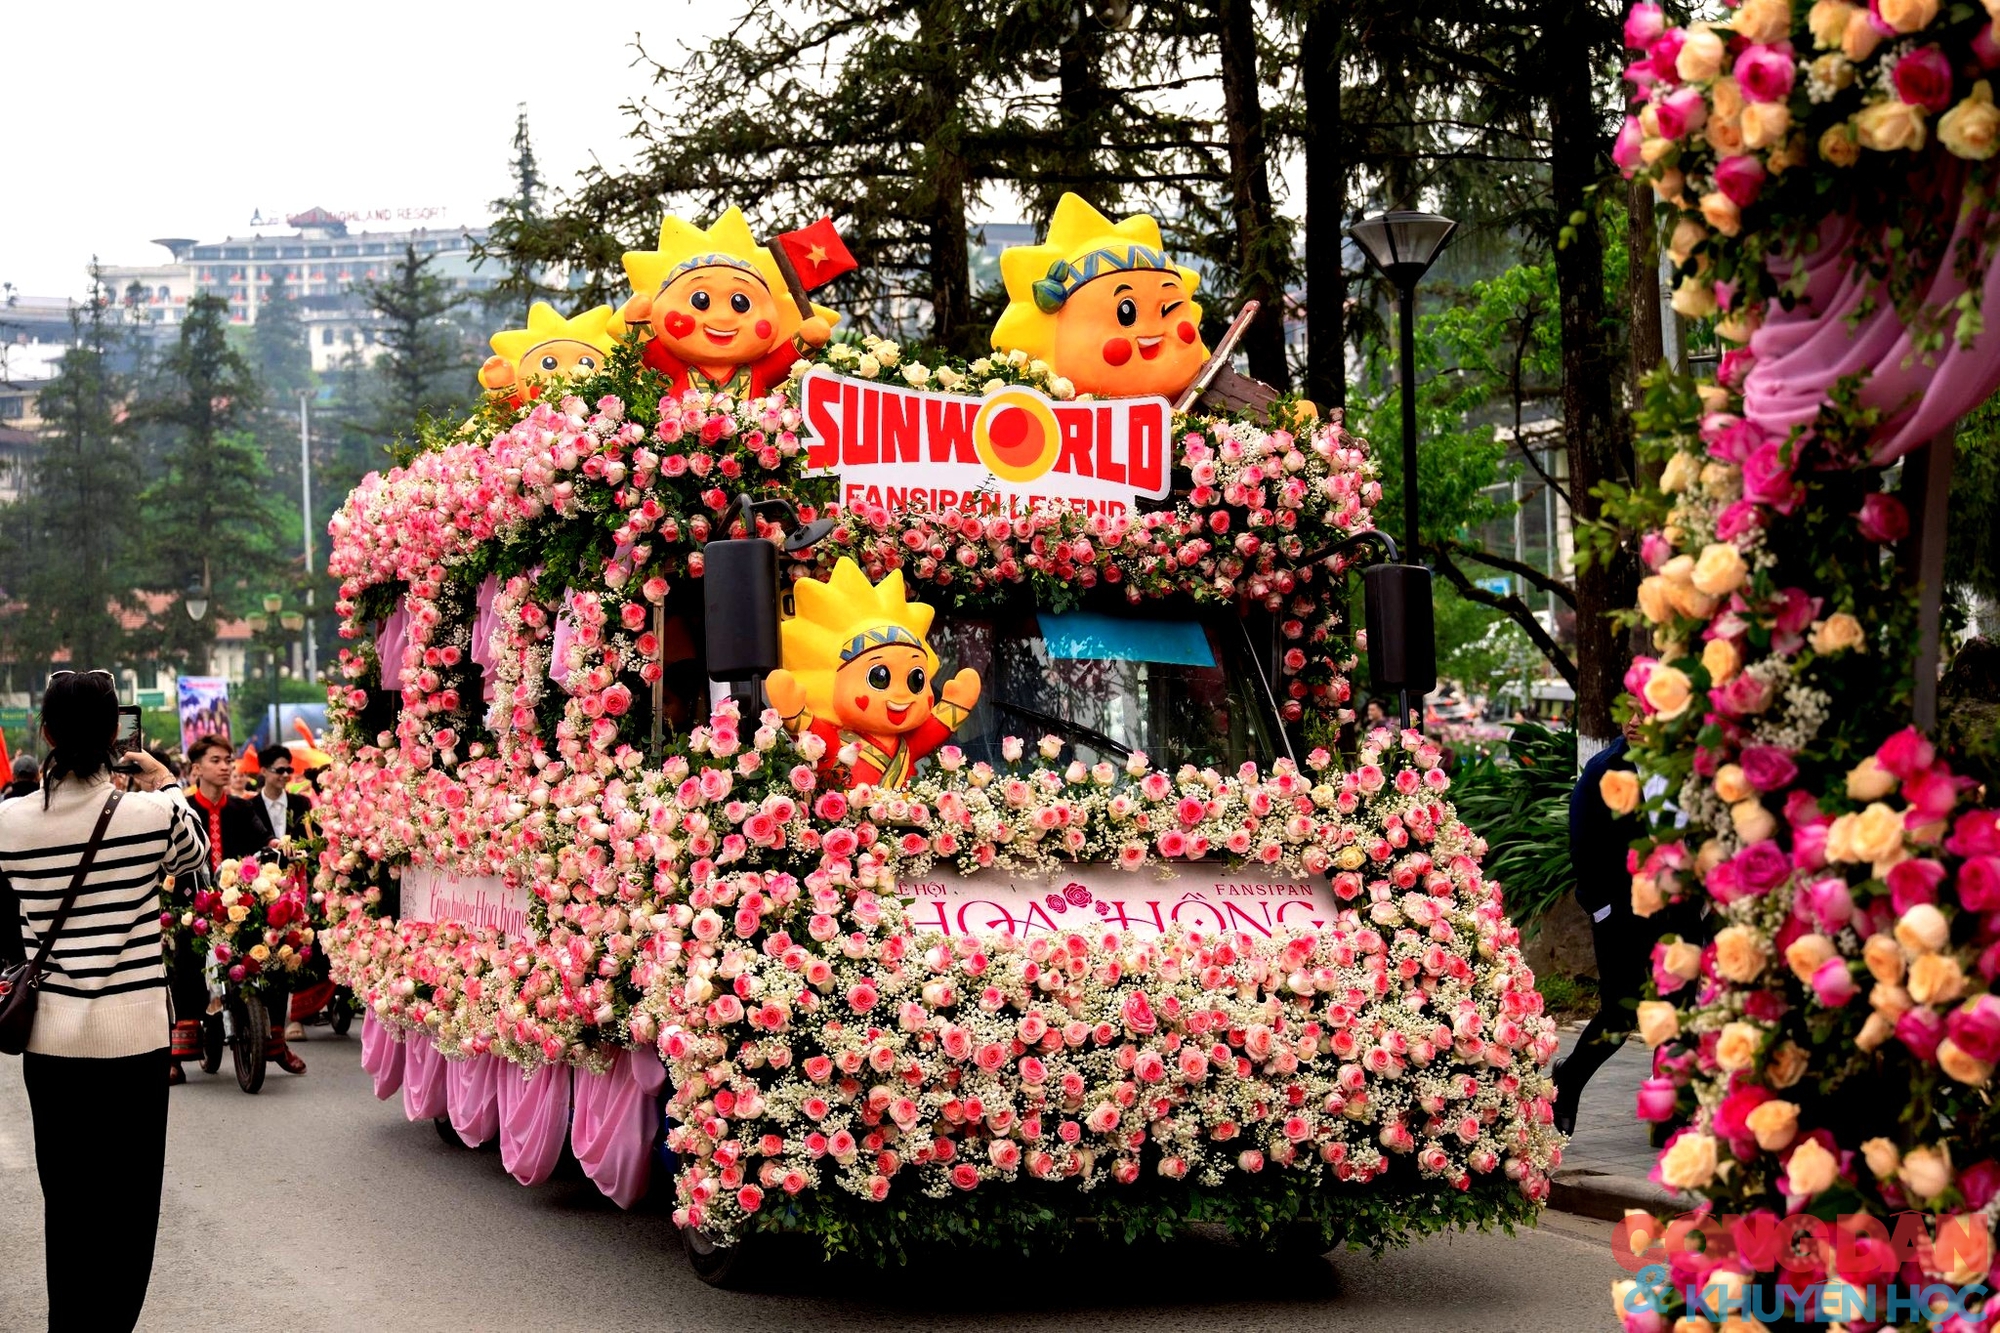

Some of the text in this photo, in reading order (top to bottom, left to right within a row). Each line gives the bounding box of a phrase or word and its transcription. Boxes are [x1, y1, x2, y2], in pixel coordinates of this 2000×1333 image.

[397, 206, 447, 221] RESORT
[915, 881, 947, 898] HỘI
[1214, 884, 1313, 896] FANSIPAN
[475, 889, 499, 929] Hoa
